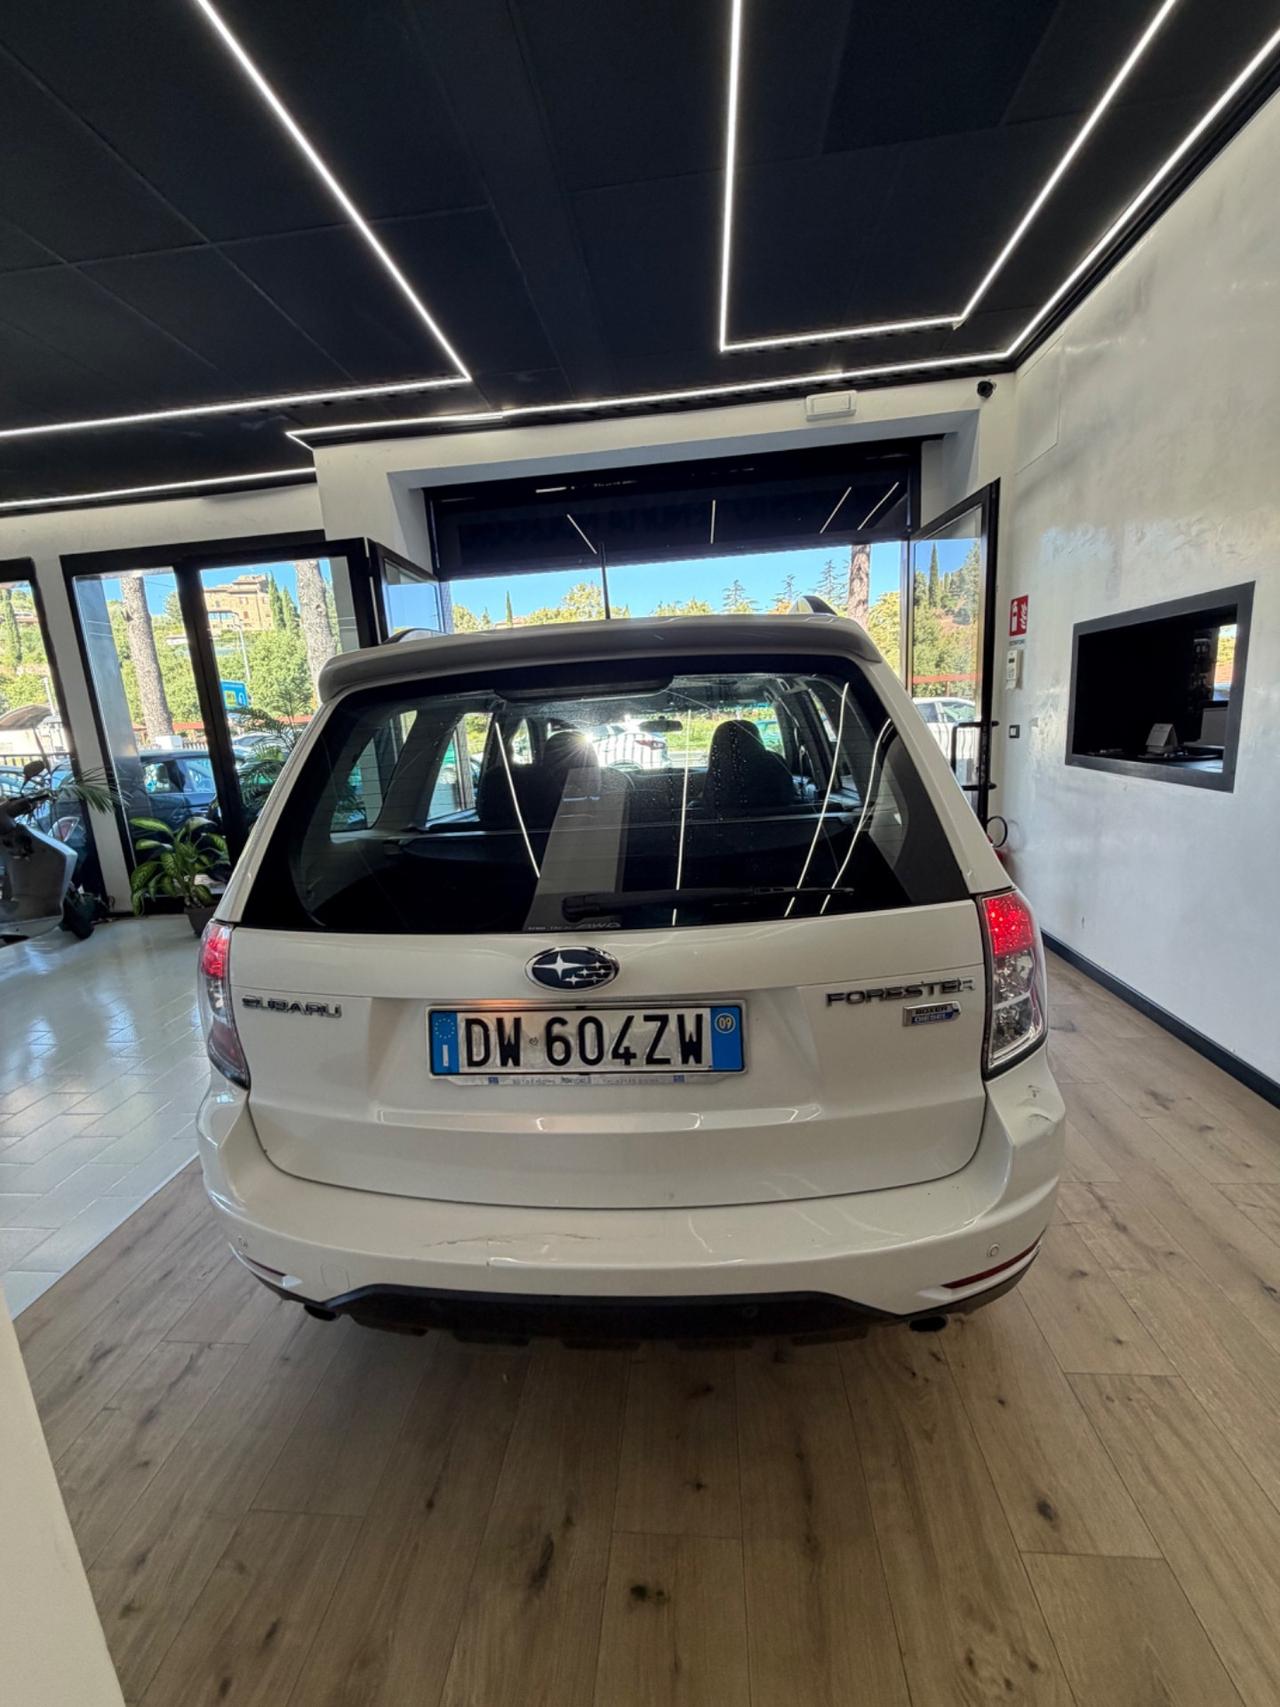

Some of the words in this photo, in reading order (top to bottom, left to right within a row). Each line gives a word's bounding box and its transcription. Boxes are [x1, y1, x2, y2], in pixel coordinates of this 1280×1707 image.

[826, 977, 975, 1007] FORESTER
[242, 995, 342, 1018] SUBARU
[718, 1016, 732, 1029] 09
[465, 1017, 522, 1067] DW
[545, 1014, 703, 1066] 604ZW
